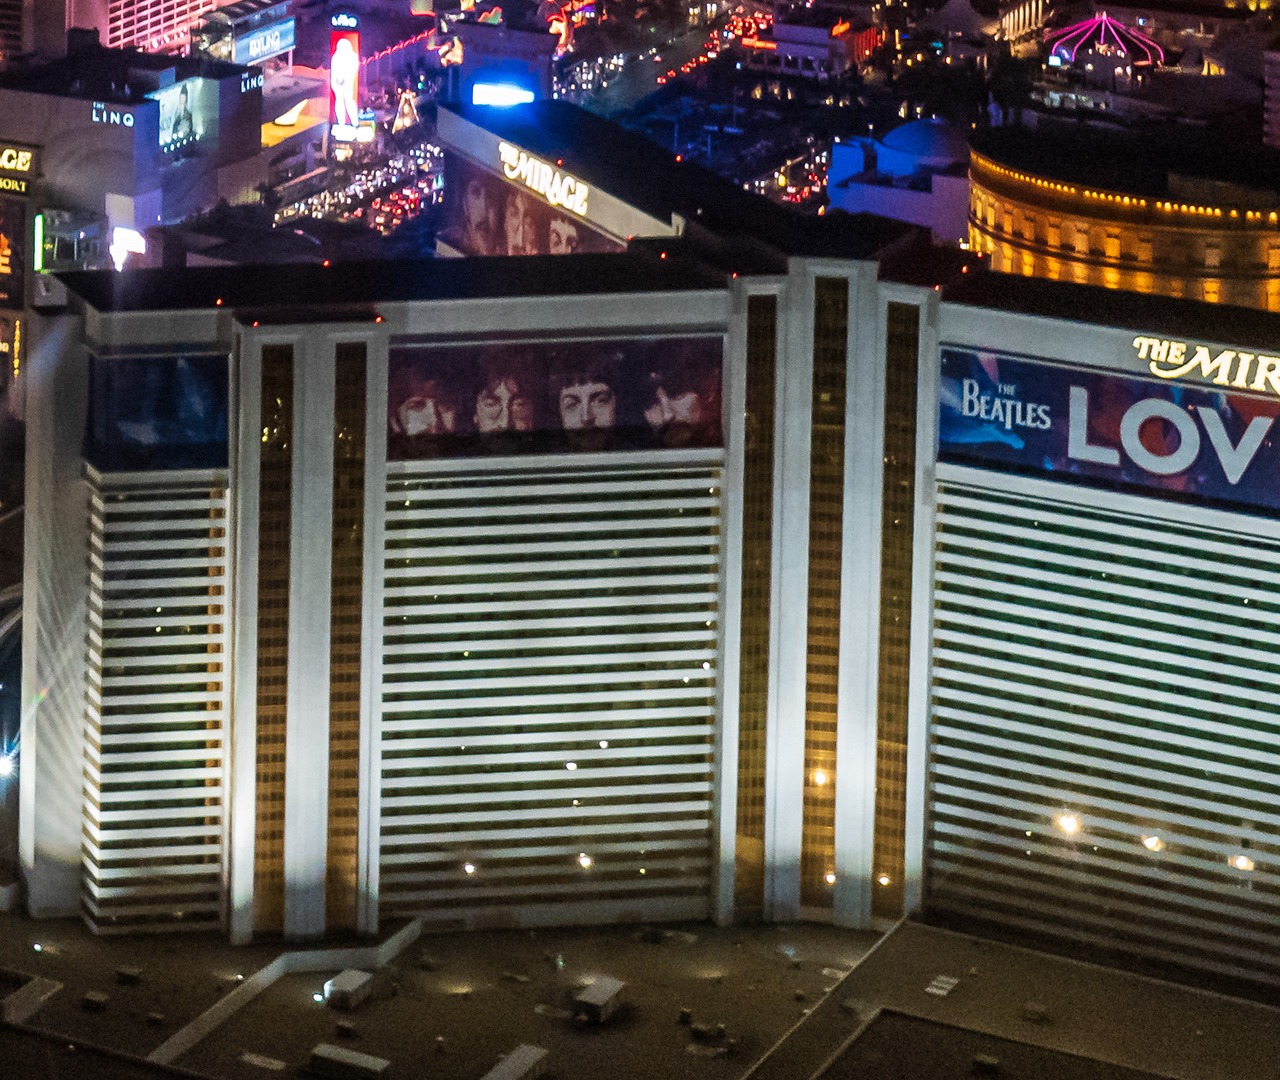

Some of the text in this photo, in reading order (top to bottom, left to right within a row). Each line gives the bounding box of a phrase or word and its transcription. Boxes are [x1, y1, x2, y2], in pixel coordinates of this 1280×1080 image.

[240, 74, 264, 93] LINQ
[92, 109, 135, 127] LINQ
[504, 152, 589, 216] MIRAGE
[1133, 336, 1187, 364] THE
[998, 382, 1017, 396] THE
[962, 378, 1052, 430] BEATLES
[1067, 384, 1276, 486] LOV
